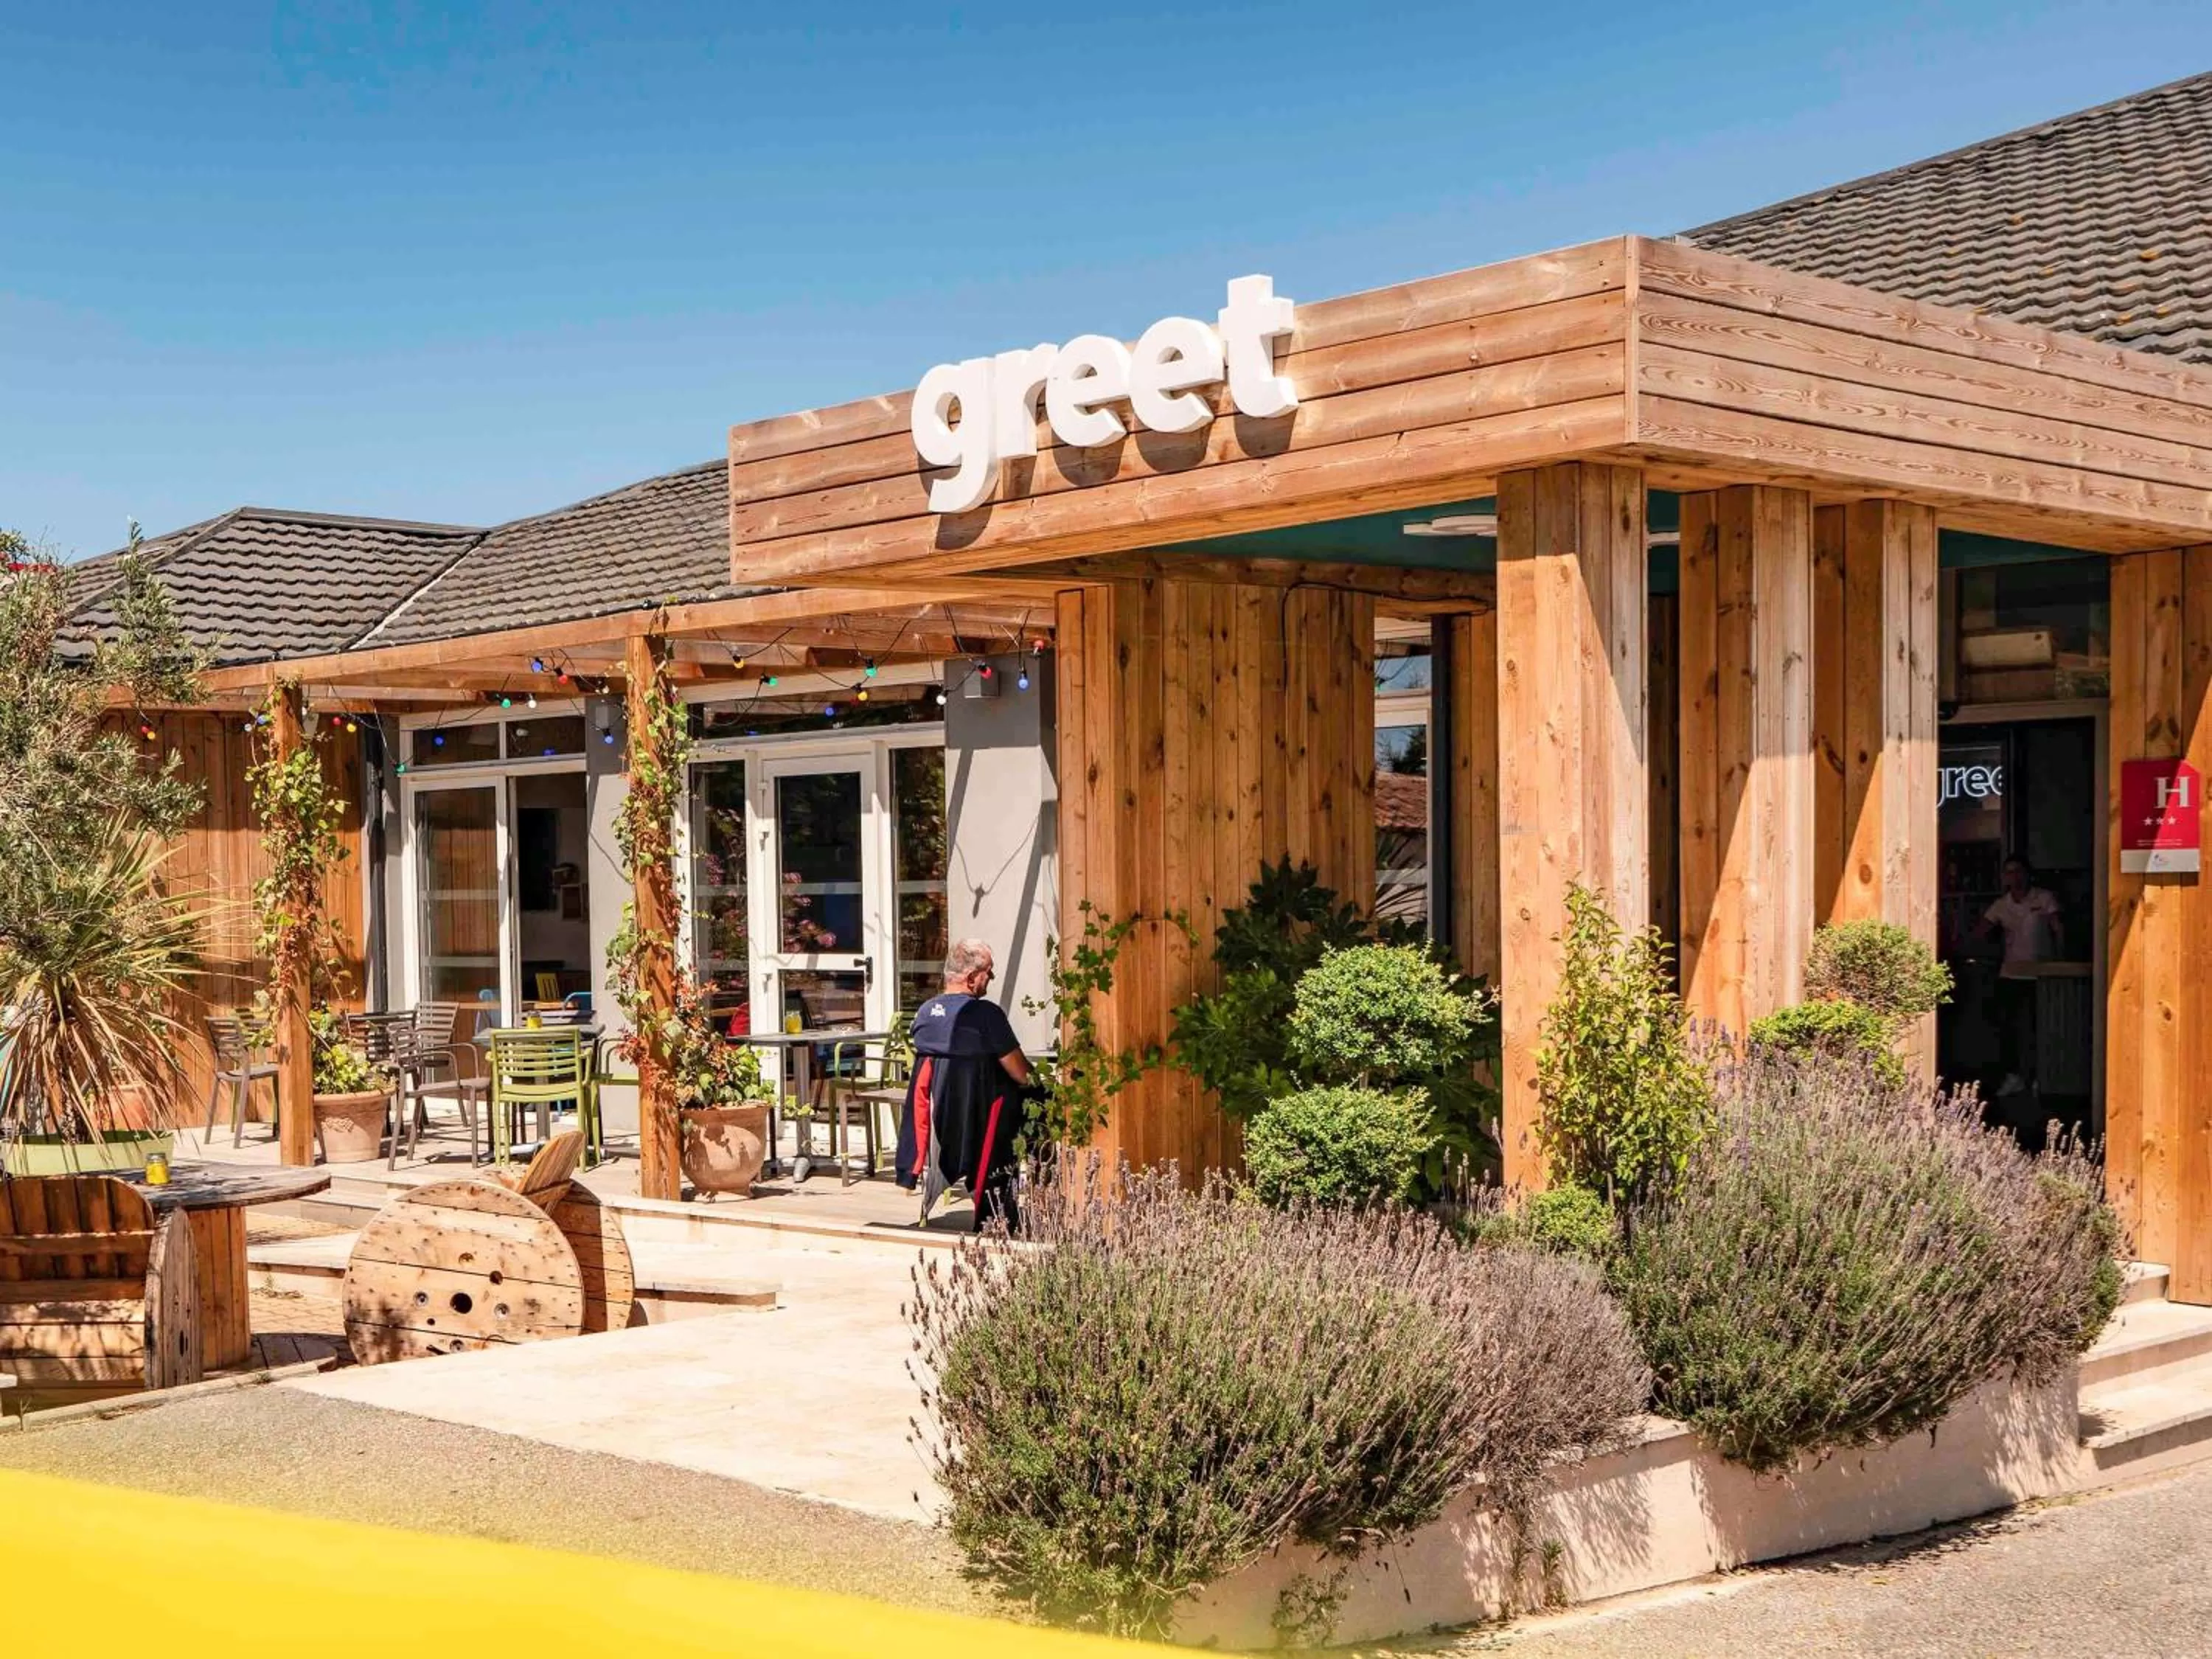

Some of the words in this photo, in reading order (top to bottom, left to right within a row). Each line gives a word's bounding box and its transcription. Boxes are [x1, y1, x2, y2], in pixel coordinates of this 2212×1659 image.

[911, 274, 1298, 513] greet
[1936, 766, 2003, 808] re
[2154, 776, 2191, 808] H
